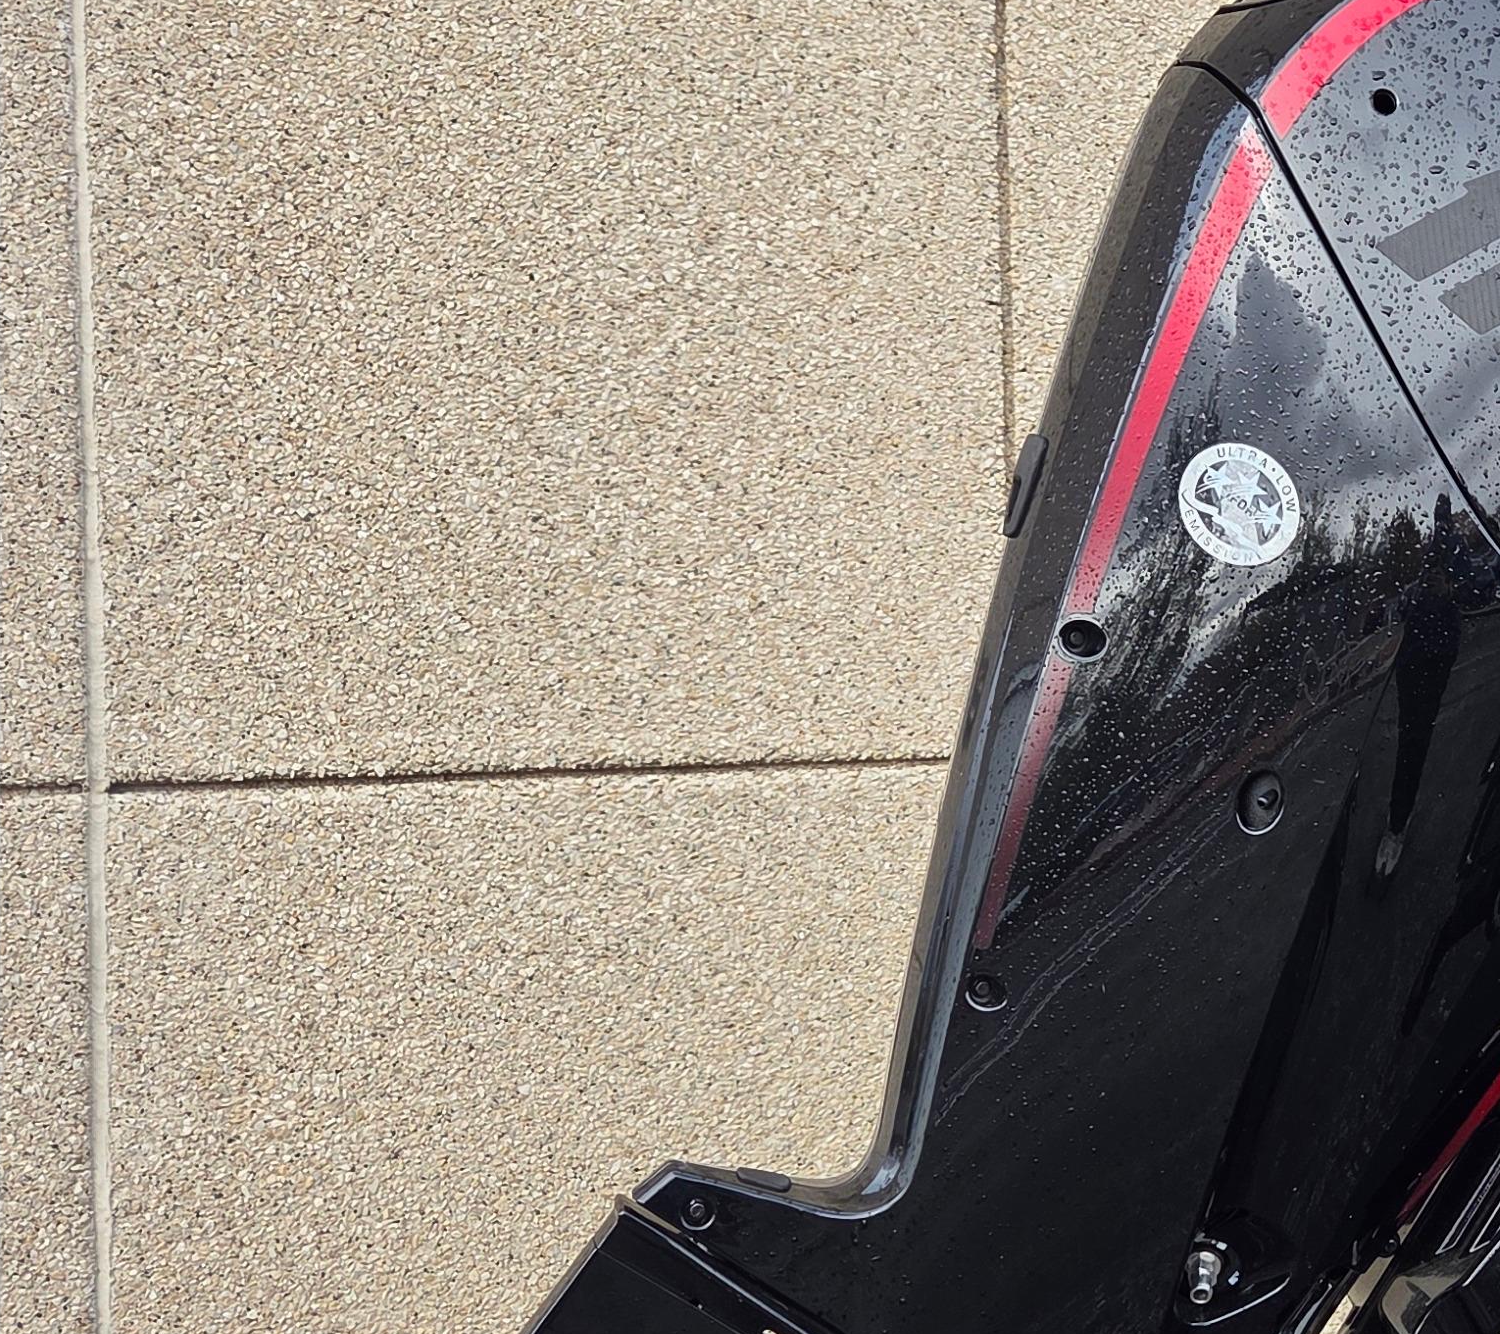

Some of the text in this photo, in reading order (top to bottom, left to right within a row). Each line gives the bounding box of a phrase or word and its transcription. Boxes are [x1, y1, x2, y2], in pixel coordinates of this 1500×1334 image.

[1216, 447, 1297, 513] ULTRA LOW
[1184, 508, 1253, 563] EMISSION
